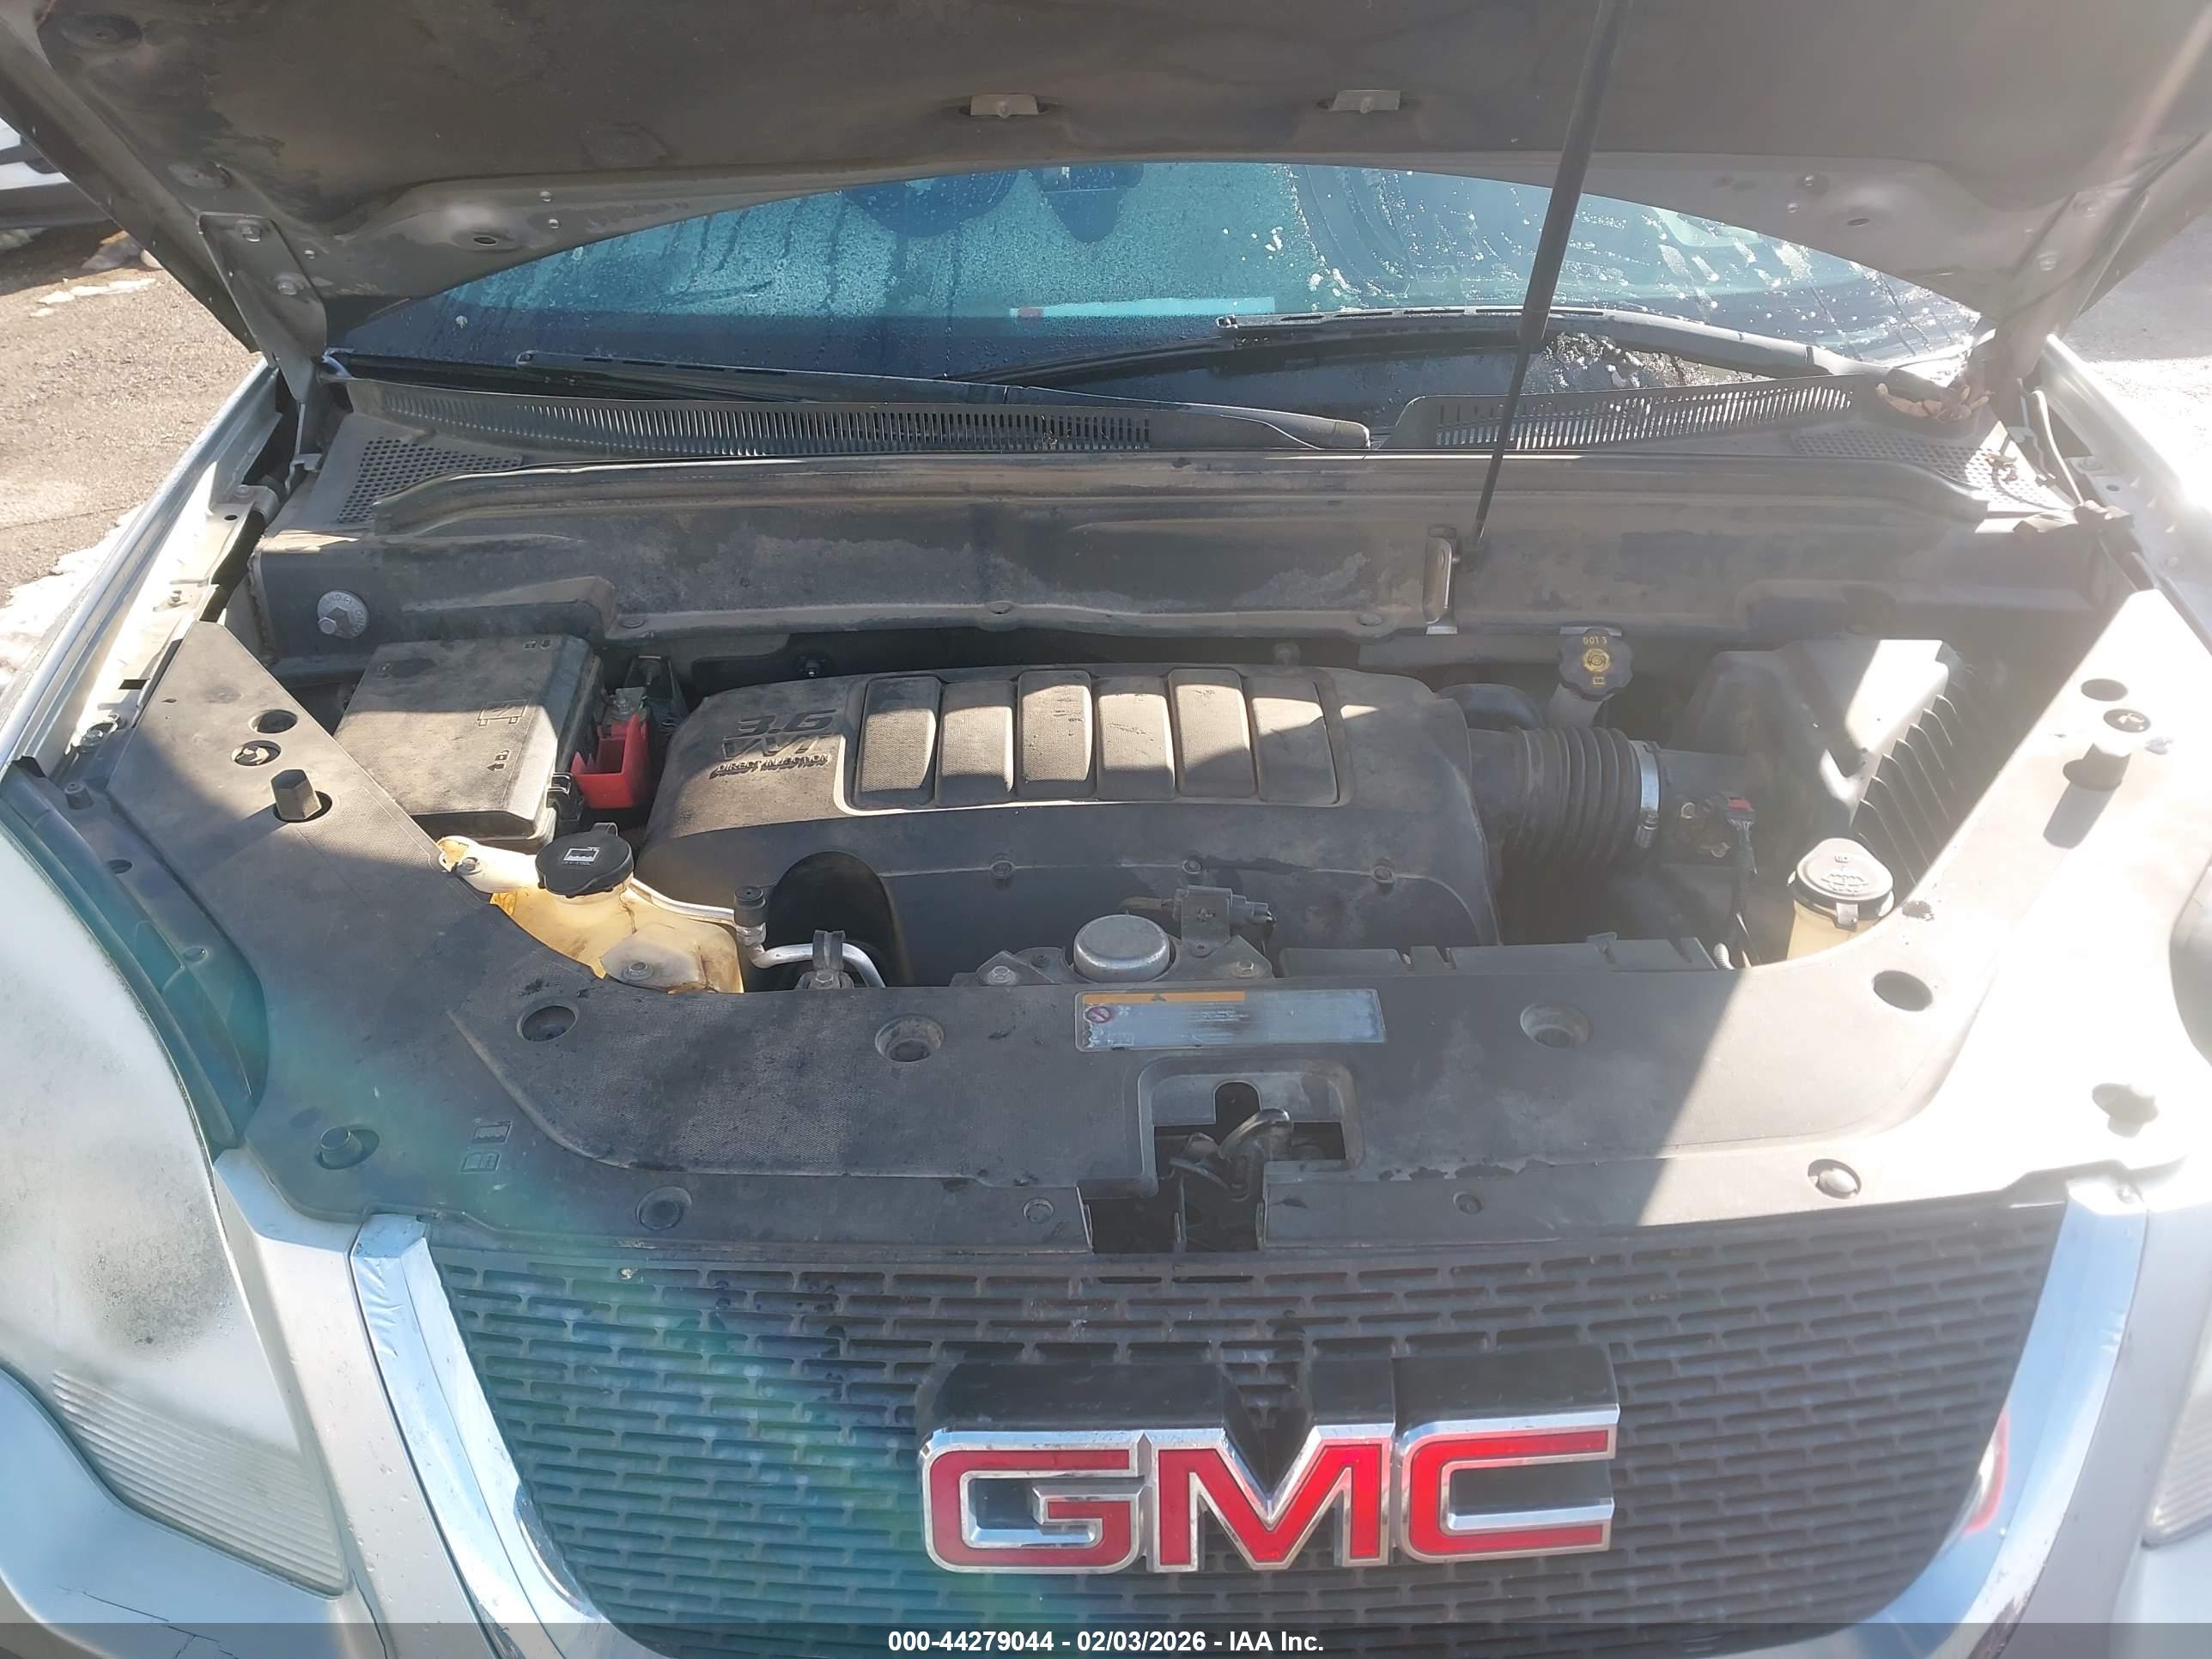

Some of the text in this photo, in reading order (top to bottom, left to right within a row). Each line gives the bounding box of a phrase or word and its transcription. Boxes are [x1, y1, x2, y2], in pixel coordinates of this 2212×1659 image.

[1583, 635, 1608, 646] DOT 3
[738, 708, 837, 737] 3.6
[709, 752, 831, 780] DIRECT INJECTION
[919, 1405, 1620, 1574] GMC
